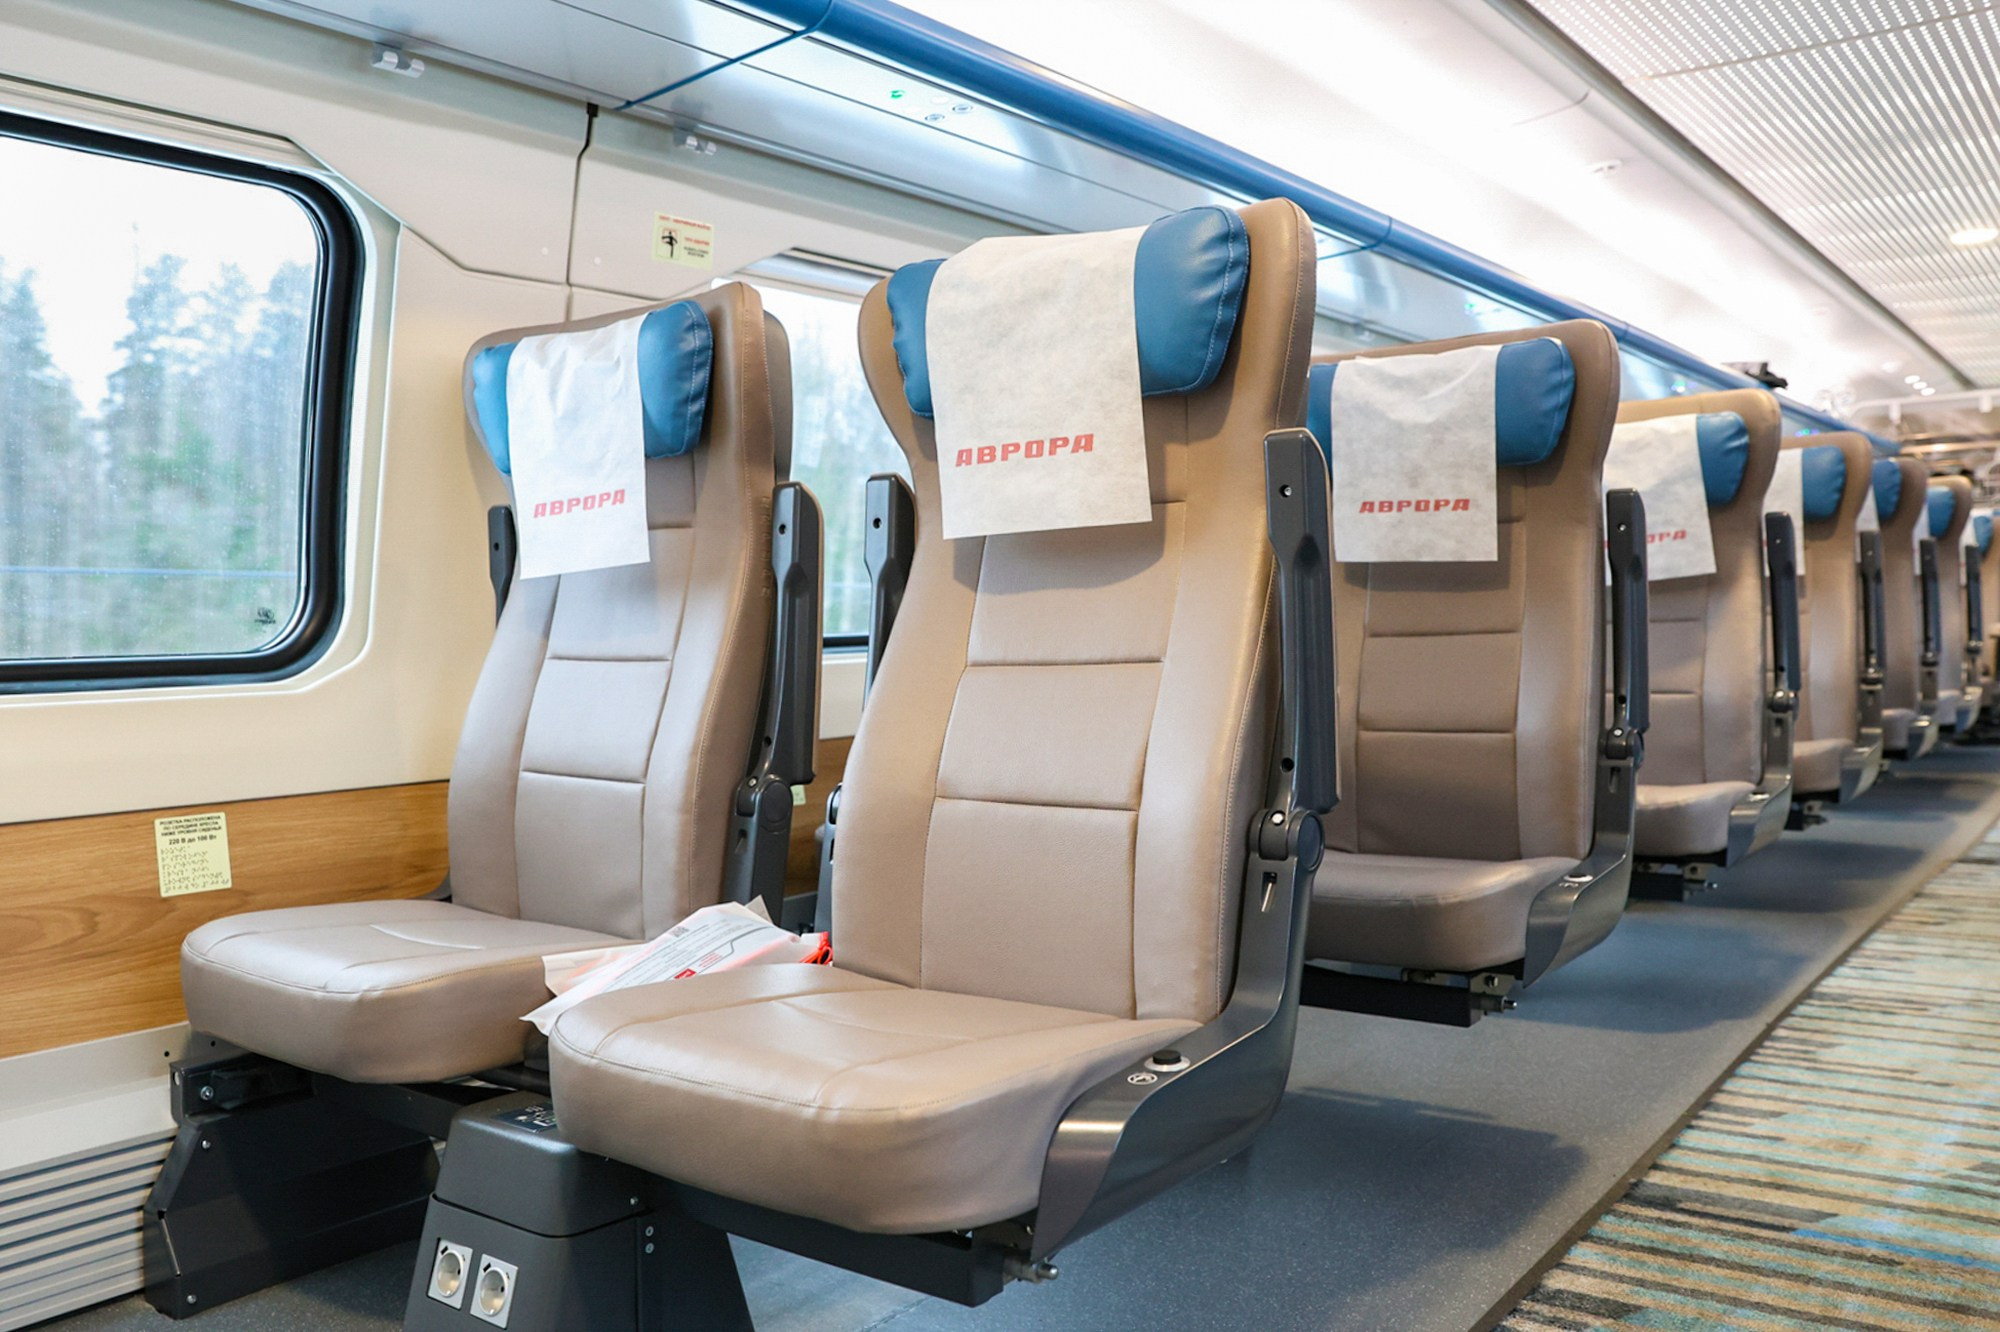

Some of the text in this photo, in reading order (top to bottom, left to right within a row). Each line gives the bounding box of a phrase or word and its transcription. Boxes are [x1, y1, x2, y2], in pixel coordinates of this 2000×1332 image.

[955, 432, 1095, 468] АВРОРА
[534, 489, 625, 518] АВРОРА
[1359, 497, 1472, 514] АВРОРА
